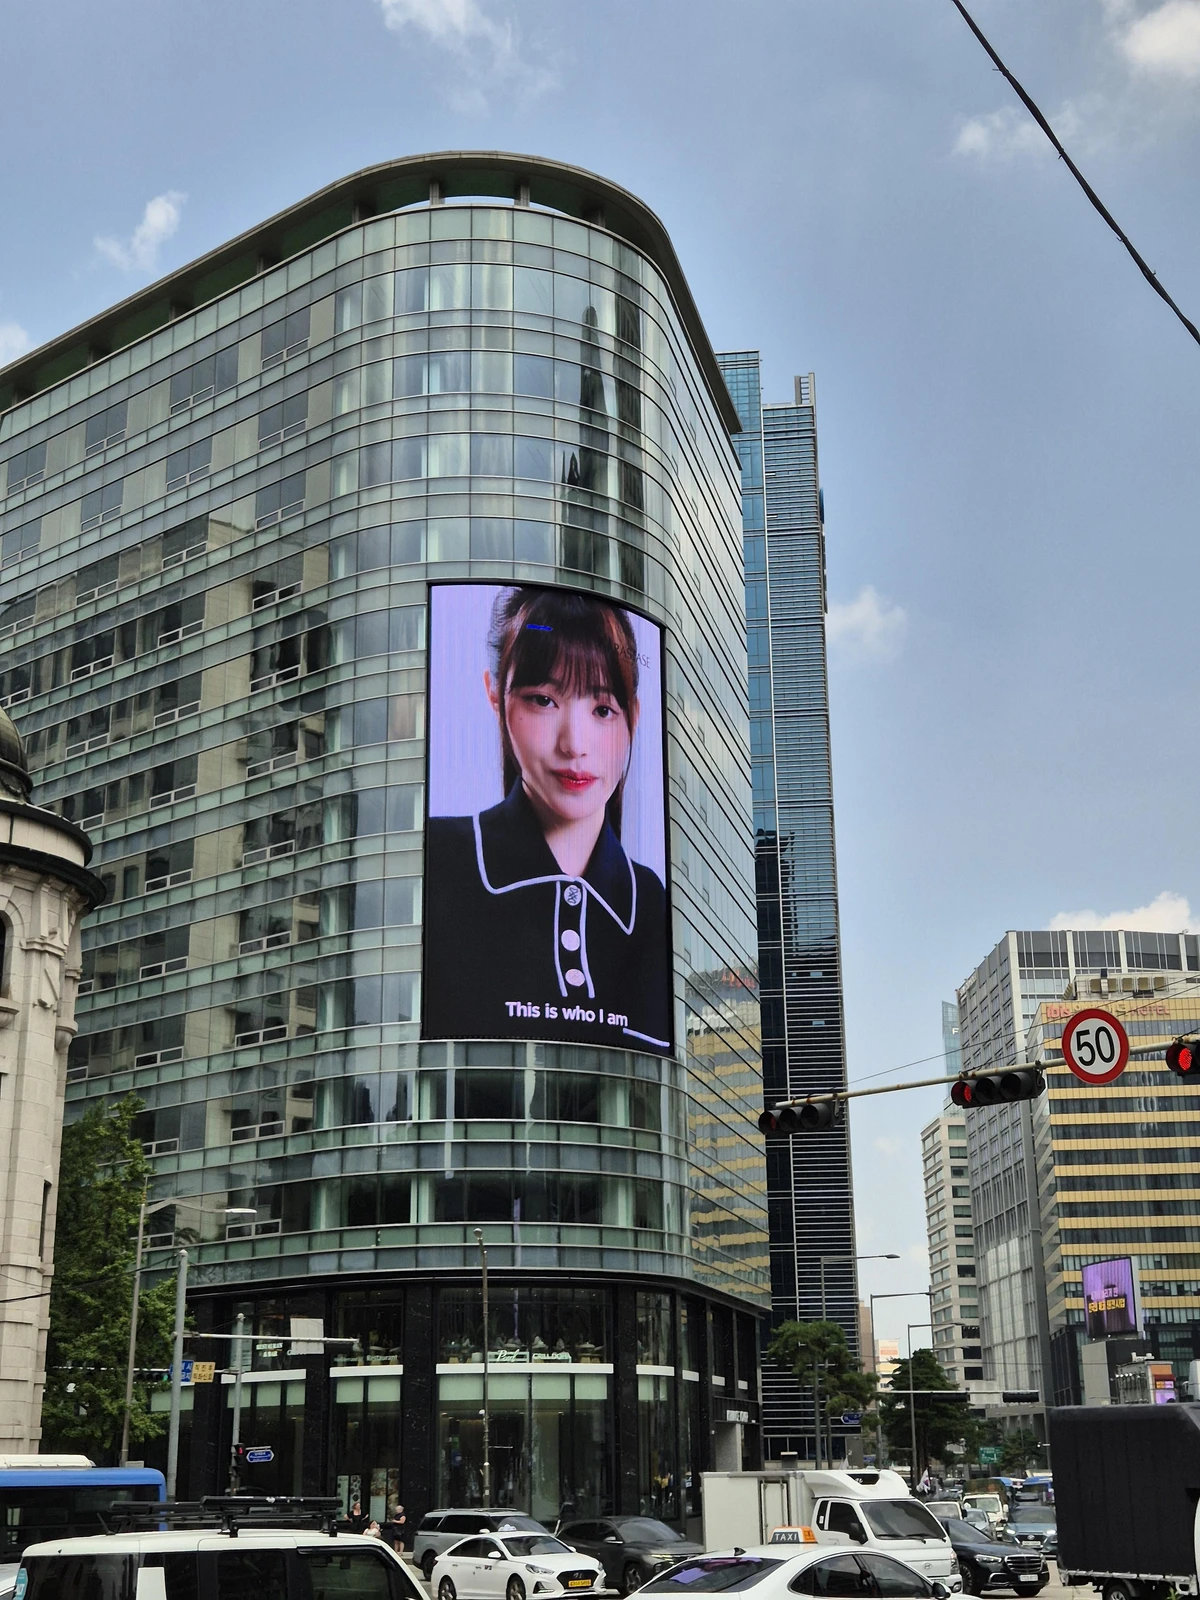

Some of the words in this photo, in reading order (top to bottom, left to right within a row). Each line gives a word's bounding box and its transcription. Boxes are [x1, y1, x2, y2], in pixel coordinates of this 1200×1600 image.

[505, 1001, 541, 1018] This
[545, 1003, 558, 1019] is
[562, 1005, 596, 1023] who
[599, 1008, 604, 1024] I
[607, 1013, 629, 1027] am
[1046, 1006, 1071, 1019] ibis
[1076, 1026, 1115, 1067] 50
[775, 1533, 797, 1541] TAXI
